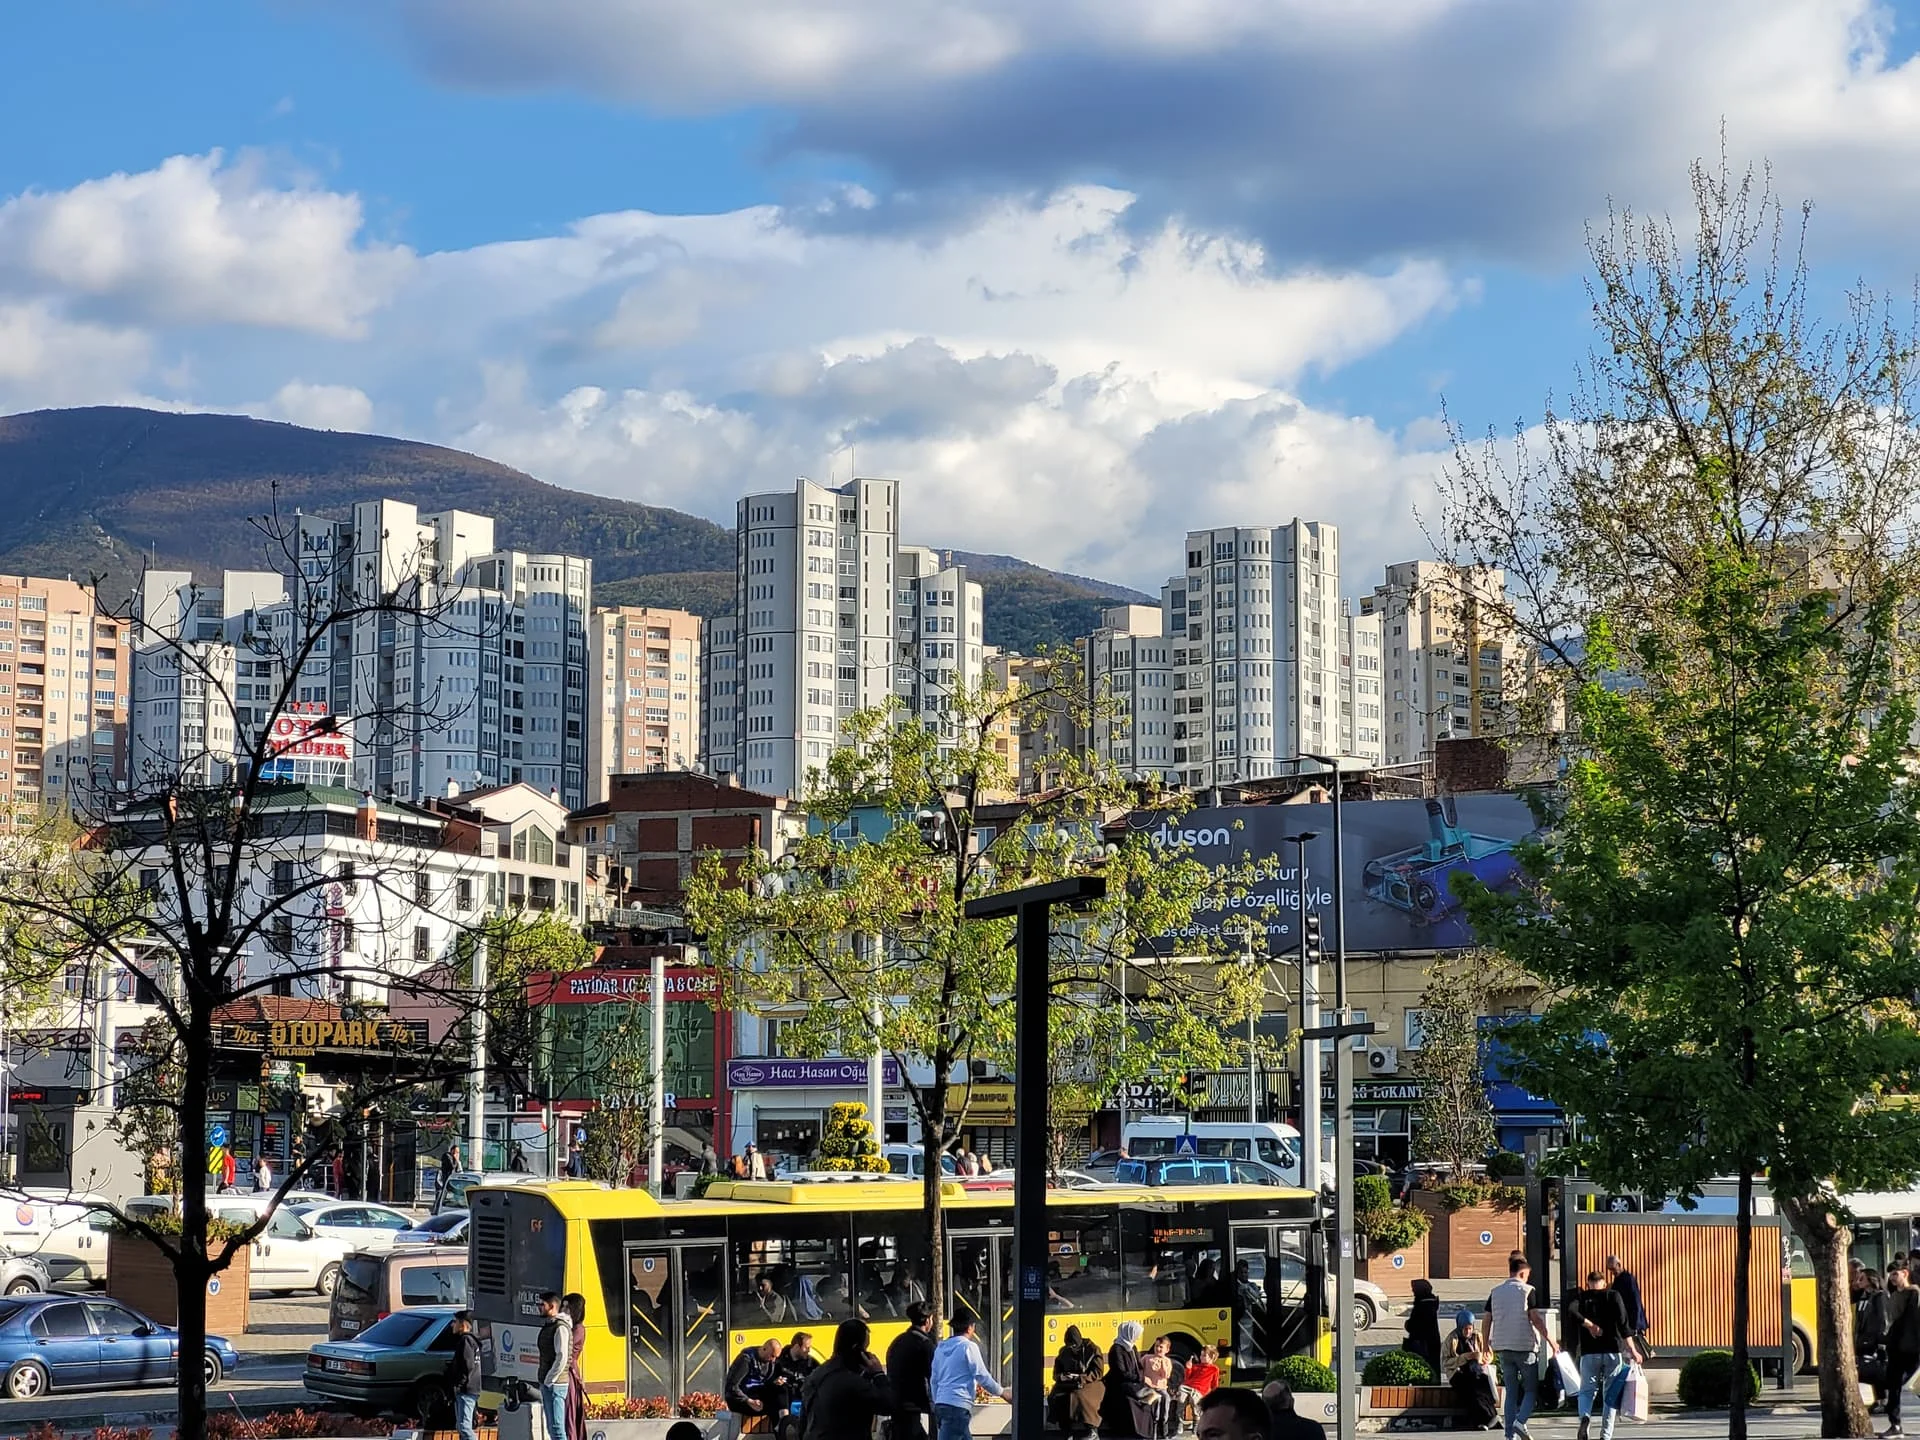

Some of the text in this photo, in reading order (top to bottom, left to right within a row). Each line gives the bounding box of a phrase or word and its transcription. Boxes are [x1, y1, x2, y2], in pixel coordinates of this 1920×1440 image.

[1245, 886, 1332, 911] özelliğyle
[570, 976, 618, 994] PAYİDAR
[622, 977, 675, 993] LOATA
[232, 1024, 258, 1044] 7/24
[271, 1020, 380, 1047] OTOPARK
[769, 1066, 796, 1079] Hacı
[799, 1065, 837, 1078] Hasan
[1320, 1083, 1367, 1099] ULAĞ
